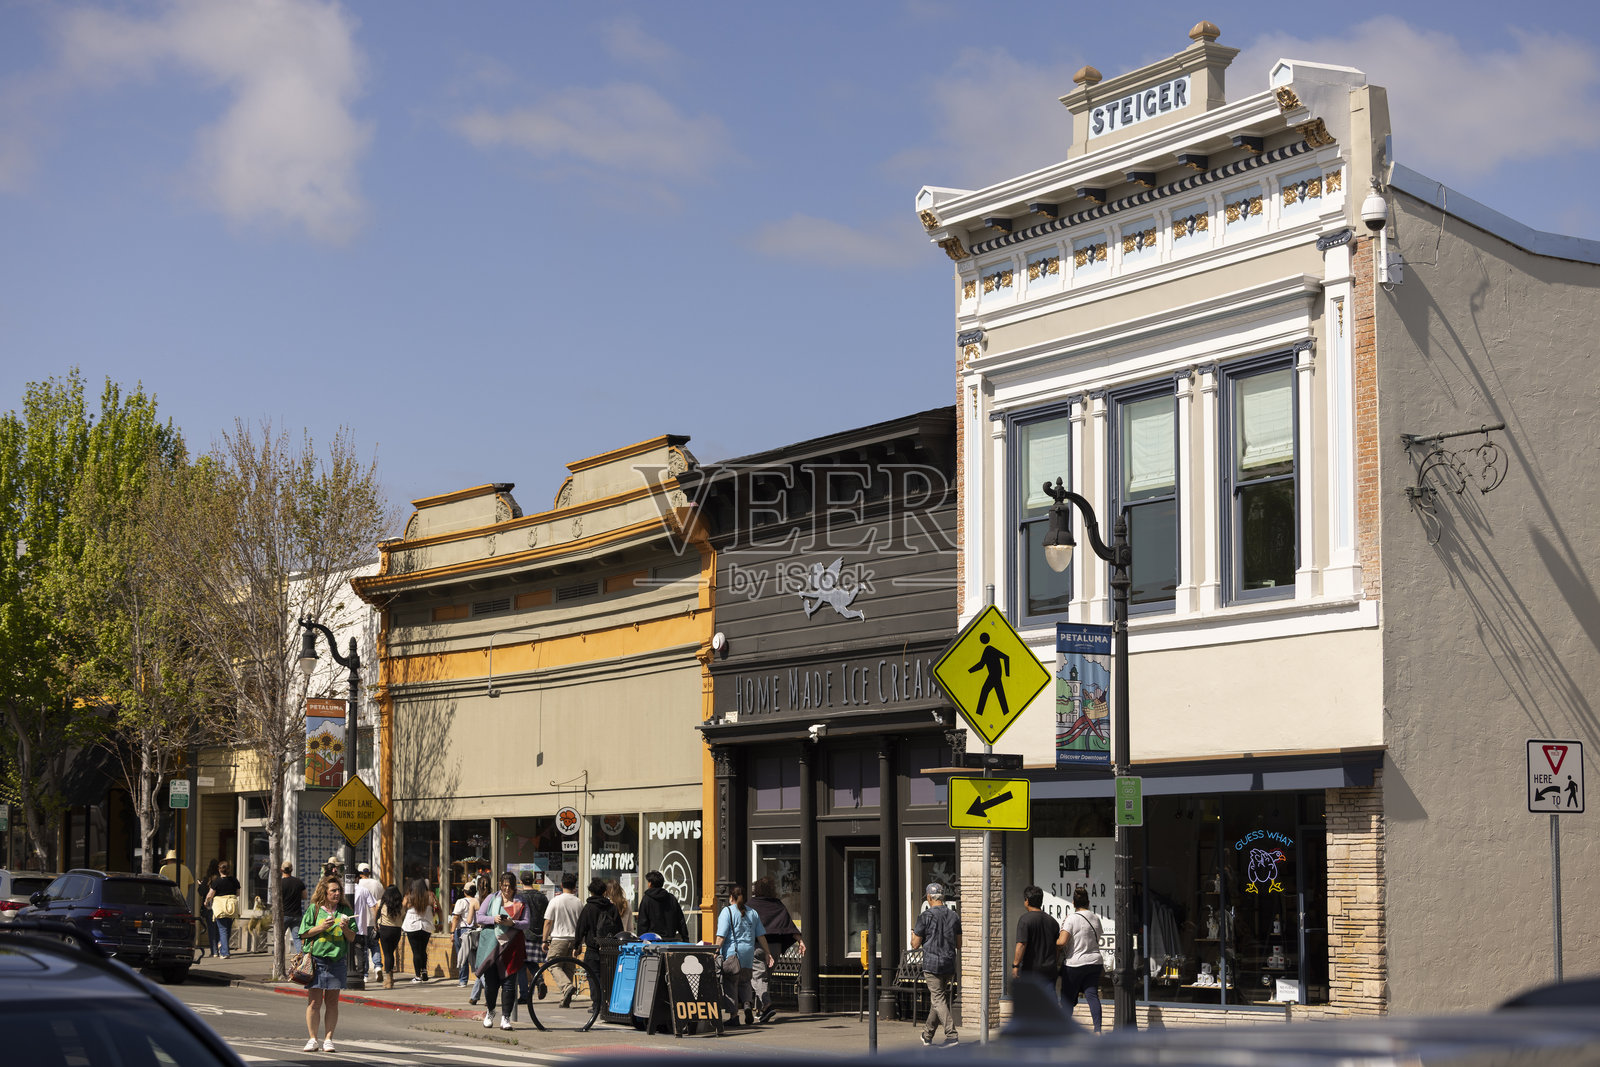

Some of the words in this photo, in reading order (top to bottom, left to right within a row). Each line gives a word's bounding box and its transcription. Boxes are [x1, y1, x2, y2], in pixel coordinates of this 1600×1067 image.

[1092, 78, 1187, 136] STEIGER
[1060, 633, 1109, 644] PETALUMA
[735, 674, 780, 716] HOME
[788, 667, 834, 711] MADE
[841, 663, 870, 706] ICE
[1534, 774, 1553, 784] HERE
[337, 799, 356, 808] RIGHT
[358, 800, 373, 808] LANE
[1552, 795, 1561, 805] TO
[335, 810, 355, 819] TURNS
[357, 811, 375, 819] RIGHT
[345, 822, 365, 831] AHEAD
[649, 819, 702, 841] POPPY'S
[1235, 830, 1265, 850] GUESS
[1266, 830, 1294, 847] WHAT
[591, 853, 613, 871] GREAT
[615, 853, 634, 870] TOYS
[676, 1001, 719, 1020] OPEN
